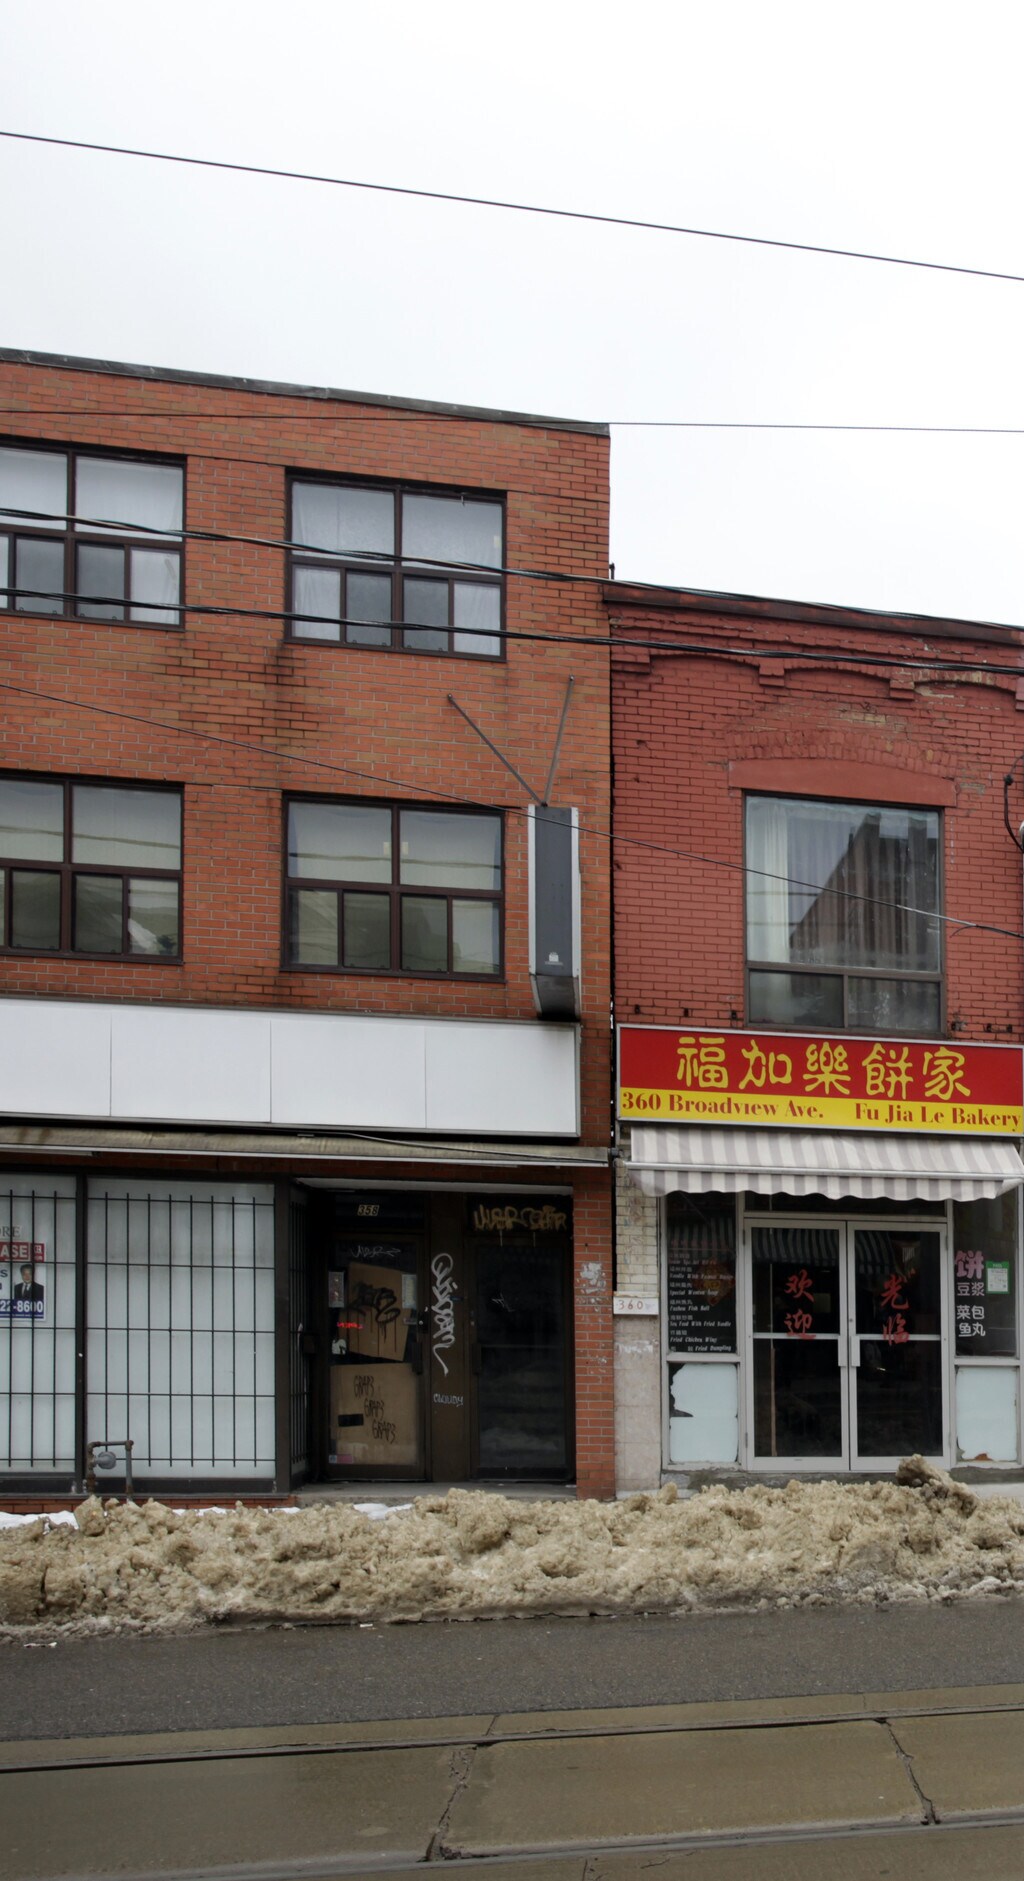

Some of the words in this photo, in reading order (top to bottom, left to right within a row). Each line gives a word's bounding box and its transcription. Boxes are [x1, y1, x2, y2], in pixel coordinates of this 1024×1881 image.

[676, 1036, 972, 1101] 福加樂餅家
[622, 1091, 662, 1112] 360
[669, 1094, 778, 1118] Broadview
[785, 1100, 824, 1119] Ave.
[855, 1103, 880, 1121] Fu
[885, 1104, 915, 1124] Jia
[920, 1106, 945, 1124] Le
[951, 1107, 1022, 1133] Bakery
[358, 1205, 379, 1216] 358
[955, 1250, 985, 1279] 饼
[957, 1282, 985, 1297] 豆浆
[619, 1299, 643, 1310] 360
[784, 1269, 816, 1341] 欢迎
[880, 1273, 910, 1347] 光临
[956, 1304, 985, 1320] 菜包
[958, 1322, 986, 1338] 鱼丸
